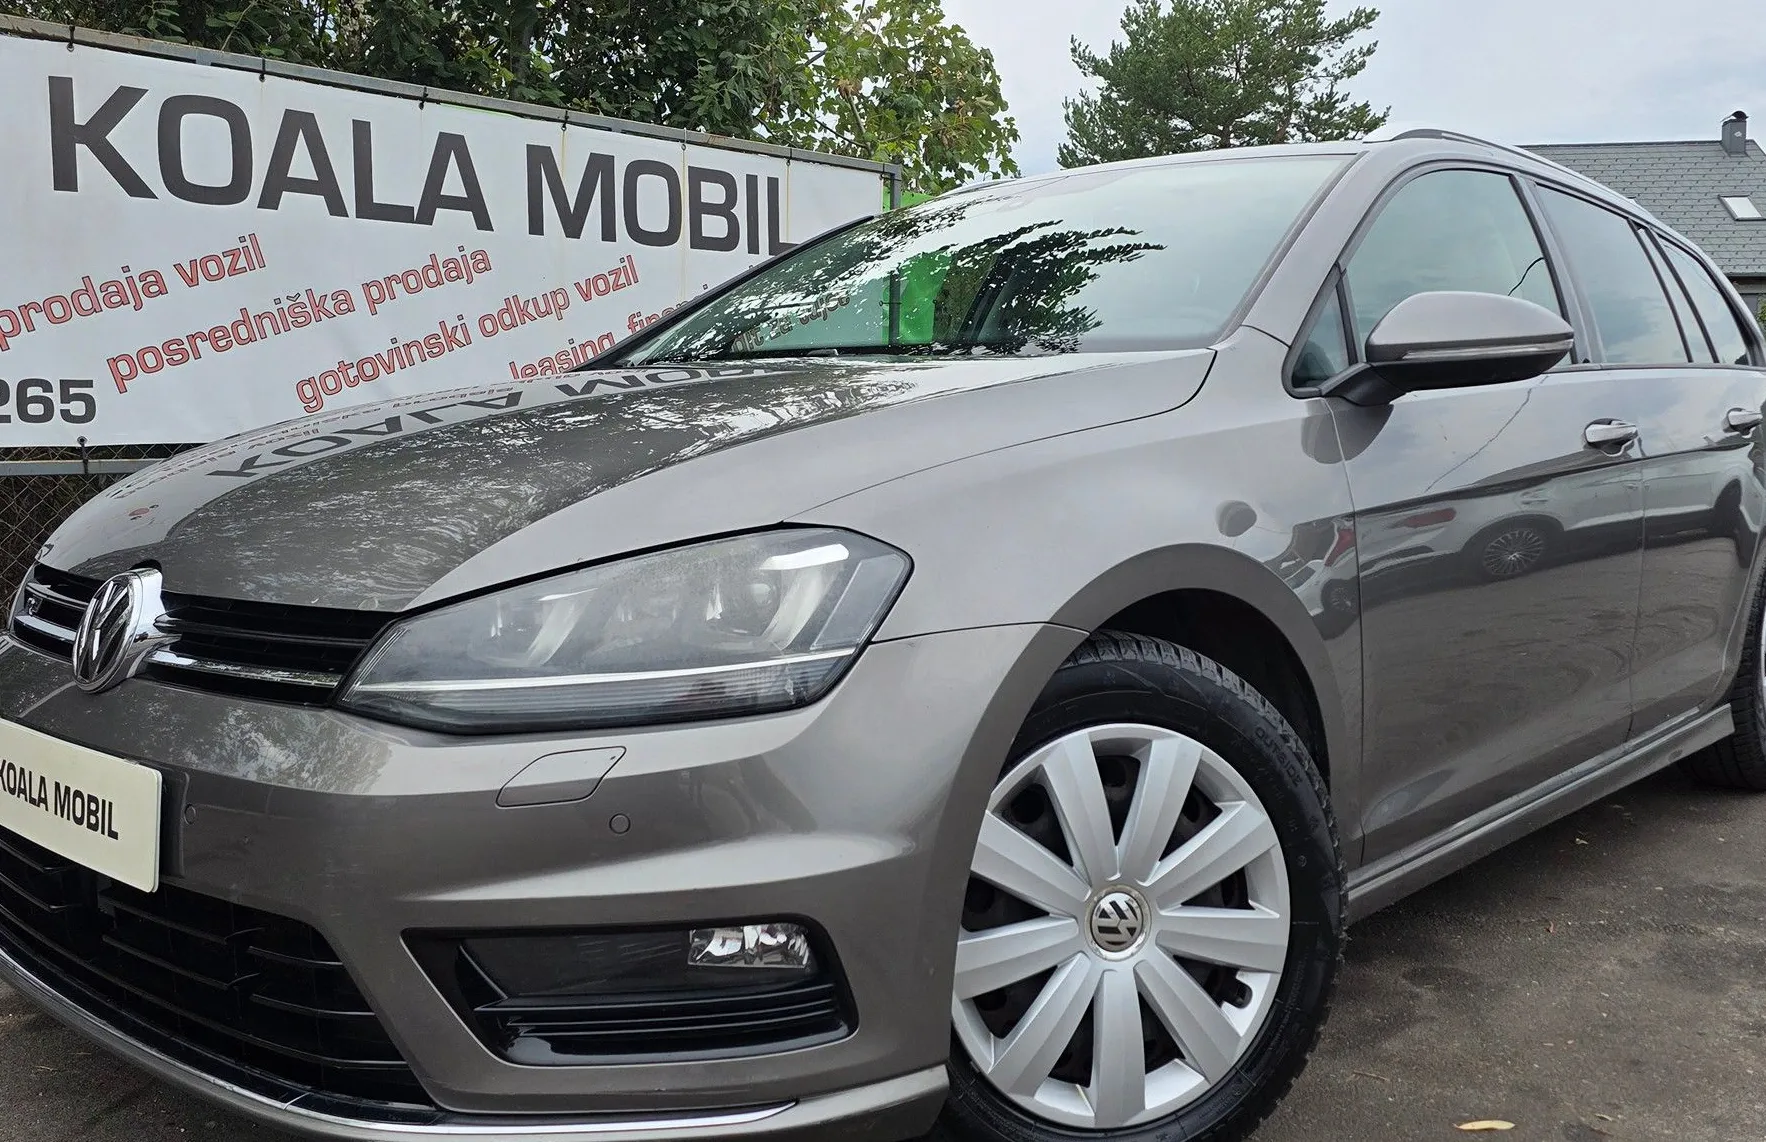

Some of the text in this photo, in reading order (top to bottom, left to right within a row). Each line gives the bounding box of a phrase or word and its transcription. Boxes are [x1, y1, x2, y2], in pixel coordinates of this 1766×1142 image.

[48, 76, 802, 256] KOALA MOBIL
[0, 233, 266, 352] prodaja vozil
[107, 245, 492, 393] posredniška prodaja
[296, 314, 473, 413] gotovinski
[478, 287, 570, 338] odkup
[574, 255, 639, 303] vozil
[54, 780, 119, 841] MOBIL
